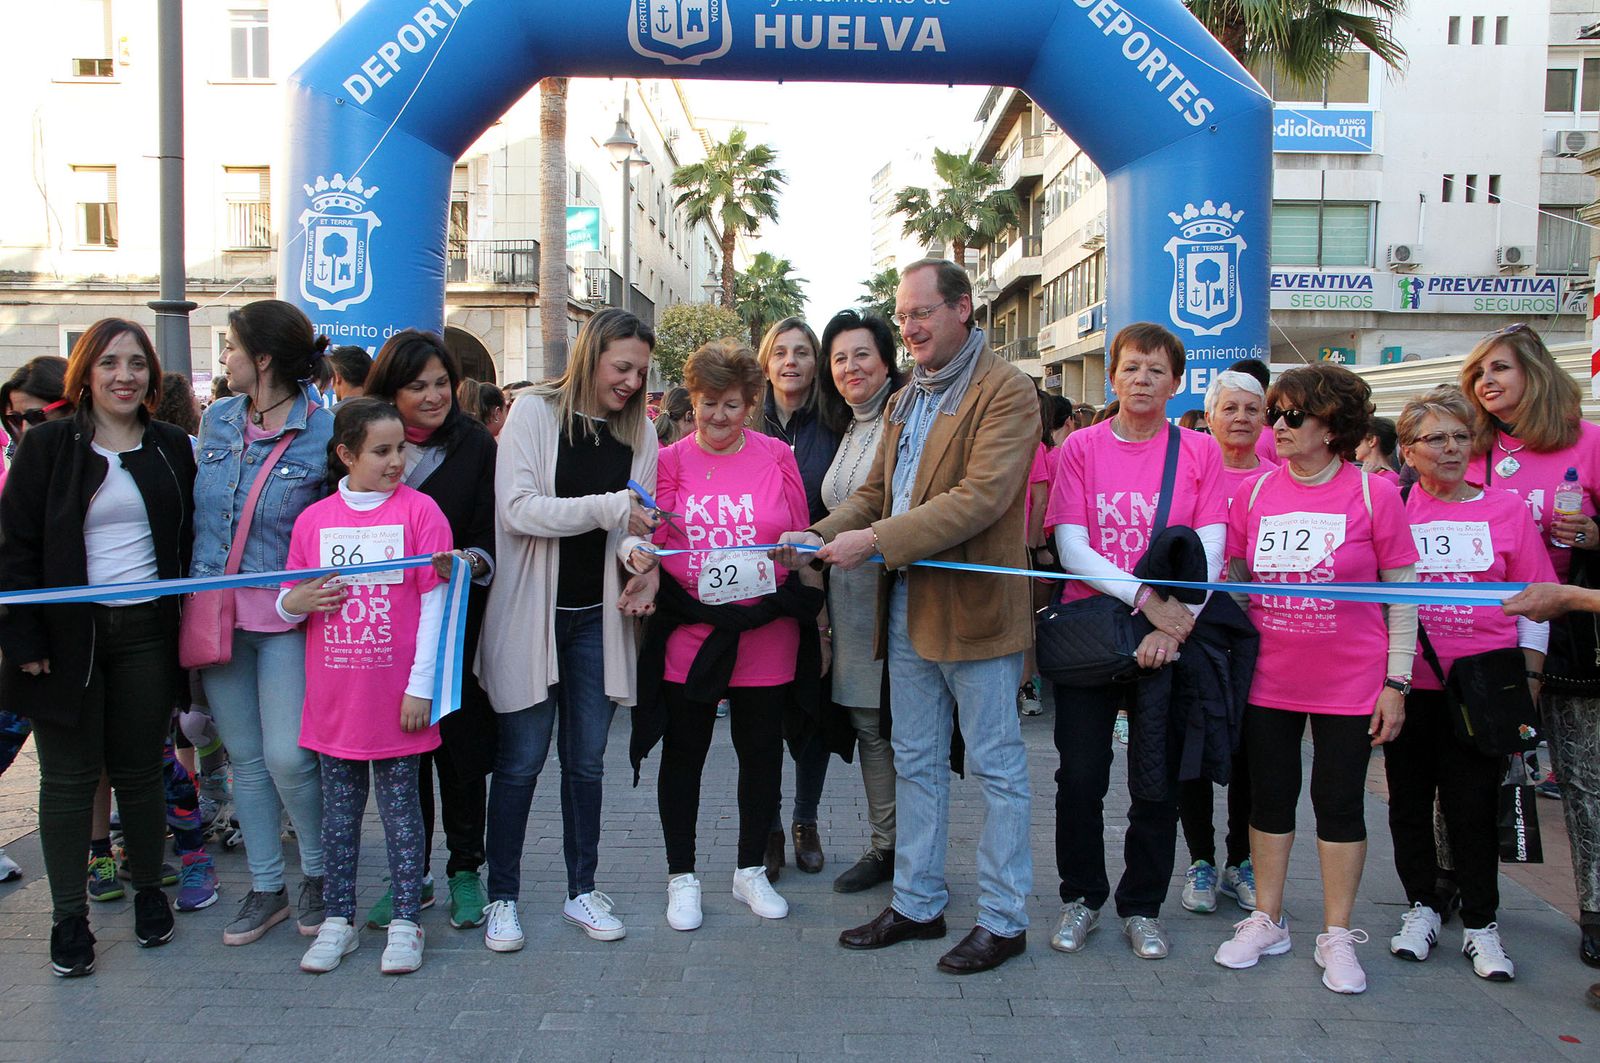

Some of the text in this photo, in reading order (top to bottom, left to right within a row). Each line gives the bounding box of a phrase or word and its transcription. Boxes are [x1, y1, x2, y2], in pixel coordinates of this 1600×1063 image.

[755, 14, 946, 52] HUELVA
[342, 0, 473, 105] DEPORT
[1073, 0, 1215, 127] EPORTES
[1273, 118, 1366, 138] diolanum
[357, 240, 365, 274] CUSTODIA
[1270, 273, 1373, 289] EVENTIVA
[1428, 277, 1556, 293] PREVENTIVA
[1290, 294, 1373, 309] SEGUROS
[1474, 297, 1556, 312] SEGUROS
[313, 321, 378, 338] amiento
[1186, 344, 1263, 361] amiento de
[1322, 347, 1346, 364] 24h
[684, 493, 755, 526] KM
[1260, 529, 1311, 552] 512
[1420, 535, 1451, 555] 13
[331, 544, 364, 567] 86
[708, 564, 739, 589] 32
[1315, 613, 1337, 621] Mujer
[323, 624, 393, 644] ELLAS
[374, 646, 393, 654] Mujer
[1514, 786, 1527, 861] tezenis.com
